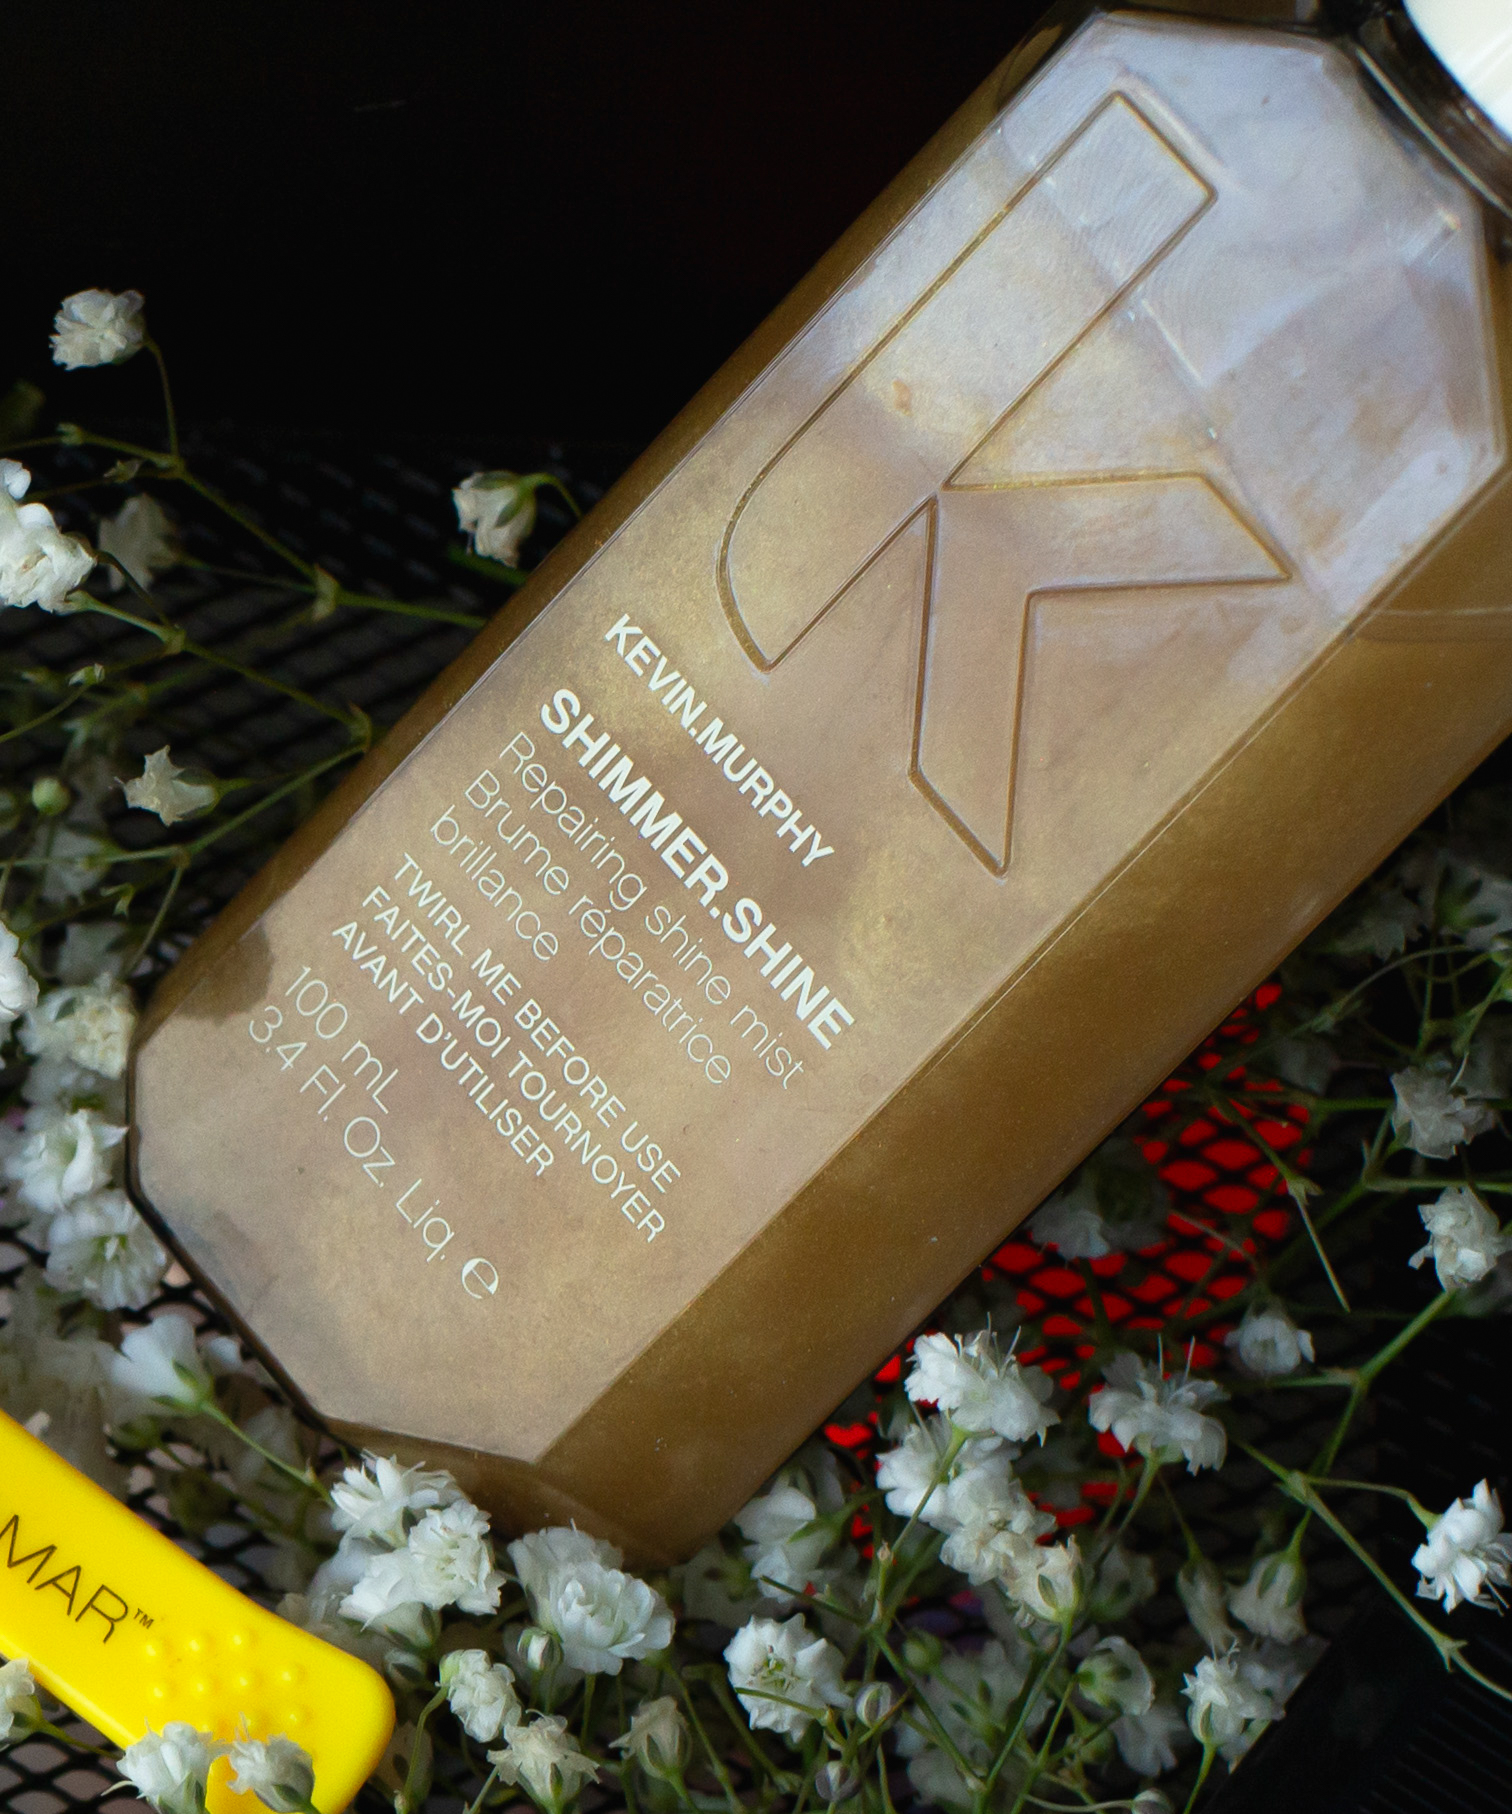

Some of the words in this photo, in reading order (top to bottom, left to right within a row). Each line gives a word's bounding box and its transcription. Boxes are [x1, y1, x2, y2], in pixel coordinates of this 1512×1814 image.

[430, 805, 558, 962] brillance
[540, 688, 855, 1050] SHIMMER.SHINE
[604, 614, 835, 869] KEVIN.MURPHY
[284, 965, 348, 1041] 100
[341, 1041, 398, 1114] mL
[332, 920, 424, 1014] AVANT
[416, 1011, 555, 1177] D'UTILISER
[394, 853, 470, 956] TWIRL
[471, 948, 522, 1008] ME
[514, 998, 627, 1128] BEFORE
[620, 1122, 681, 1194] USE
[465, 769, 570, 896] Brume
[568, 891, 731, 1085] réparatrice
[498, 731, 647, 911] Repairing
[645, 905, 731, 1005] shine
[731, 1003, 805, 1090] mist
[248, 1005, 308, 1071] 3.4
[344, 1114, 396, 1188] Oz.
[395, 1178, 455, 1264] Liq.
[362, 886, 511, 1058] FAITES-MOI
[507, 1050, 666, 1242] TOURNOYER
